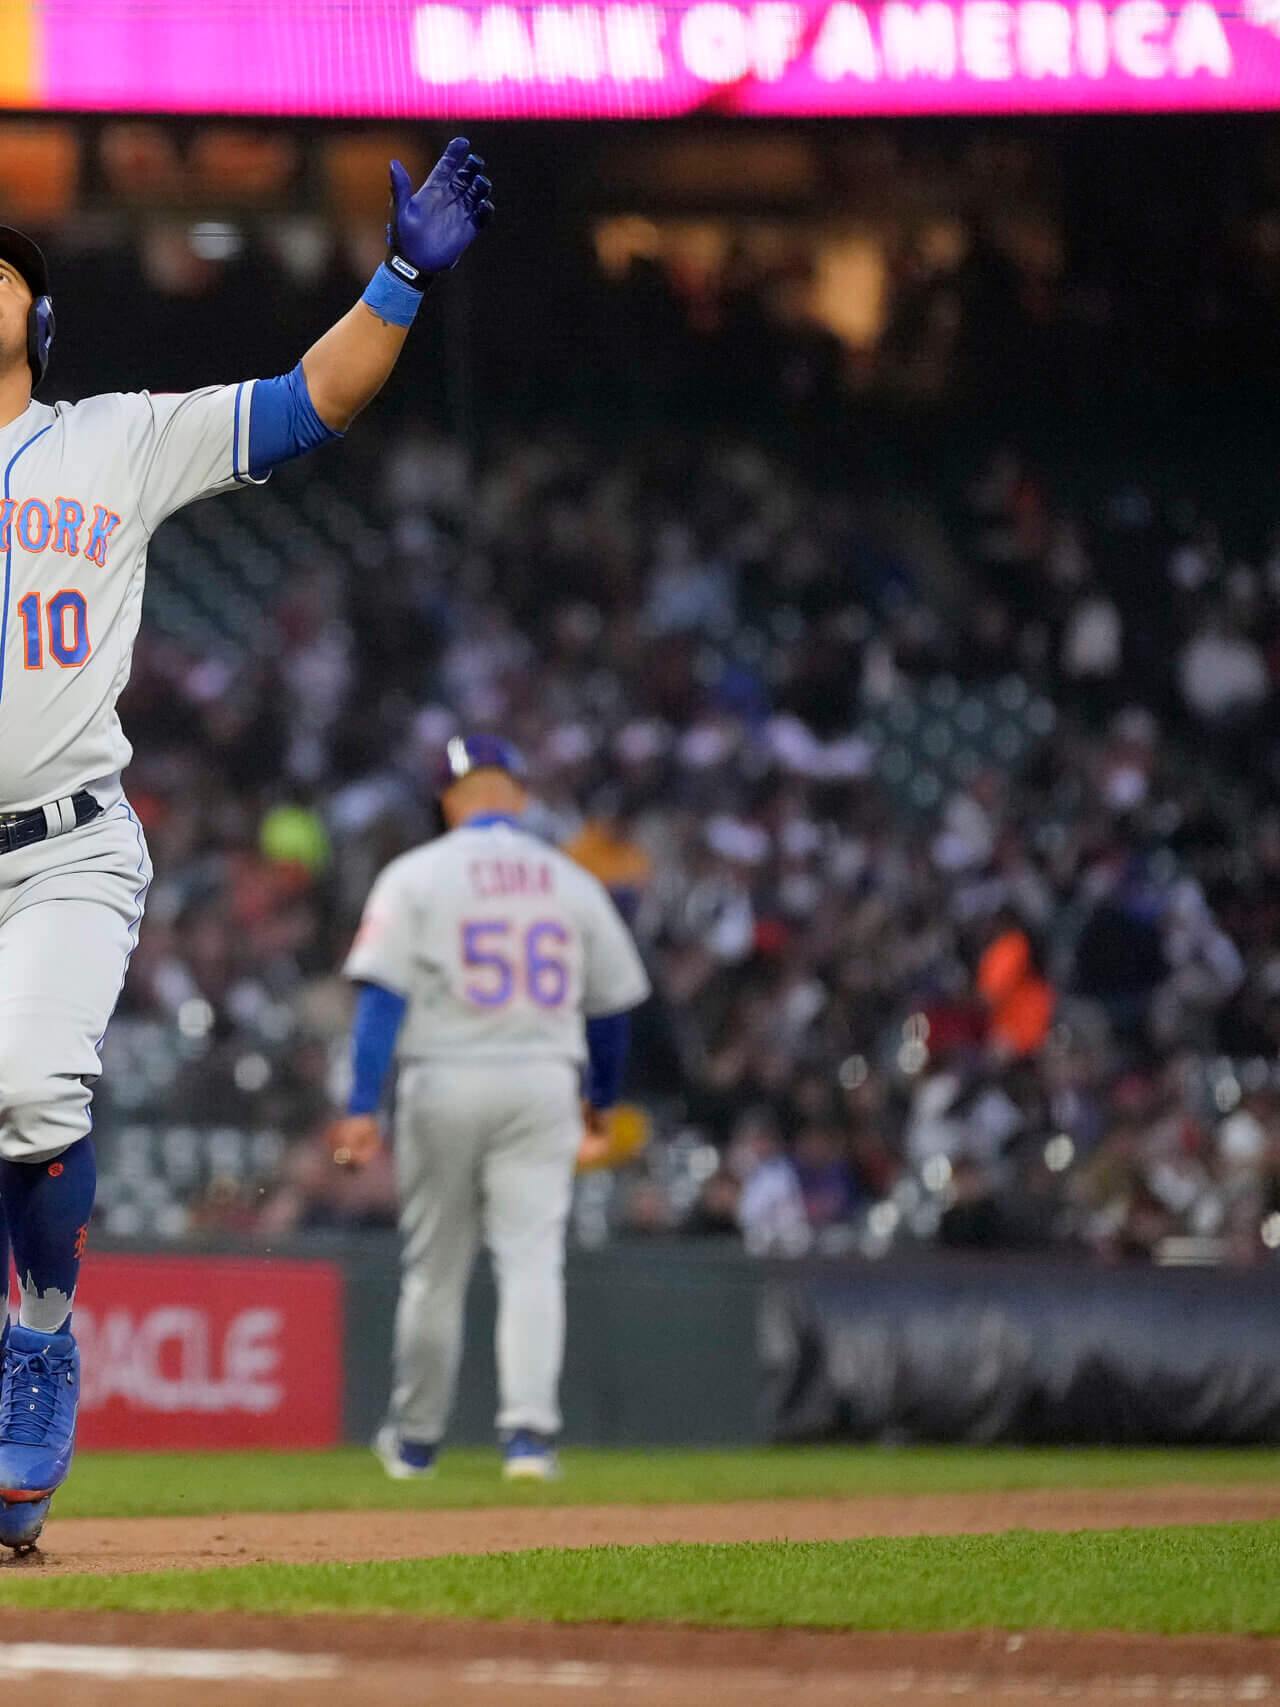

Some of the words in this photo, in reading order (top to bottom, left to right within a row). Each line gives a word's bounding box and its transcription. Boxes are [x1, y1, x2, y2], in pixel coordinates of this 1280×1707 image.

[416, 3, 665, 82] BANK
[680, 3, 798, 82] OF
[812, 2, 1234, 80] AMERICA
[18, 589, 92, 670] 10
[461, 919, 570, 1011] 56
